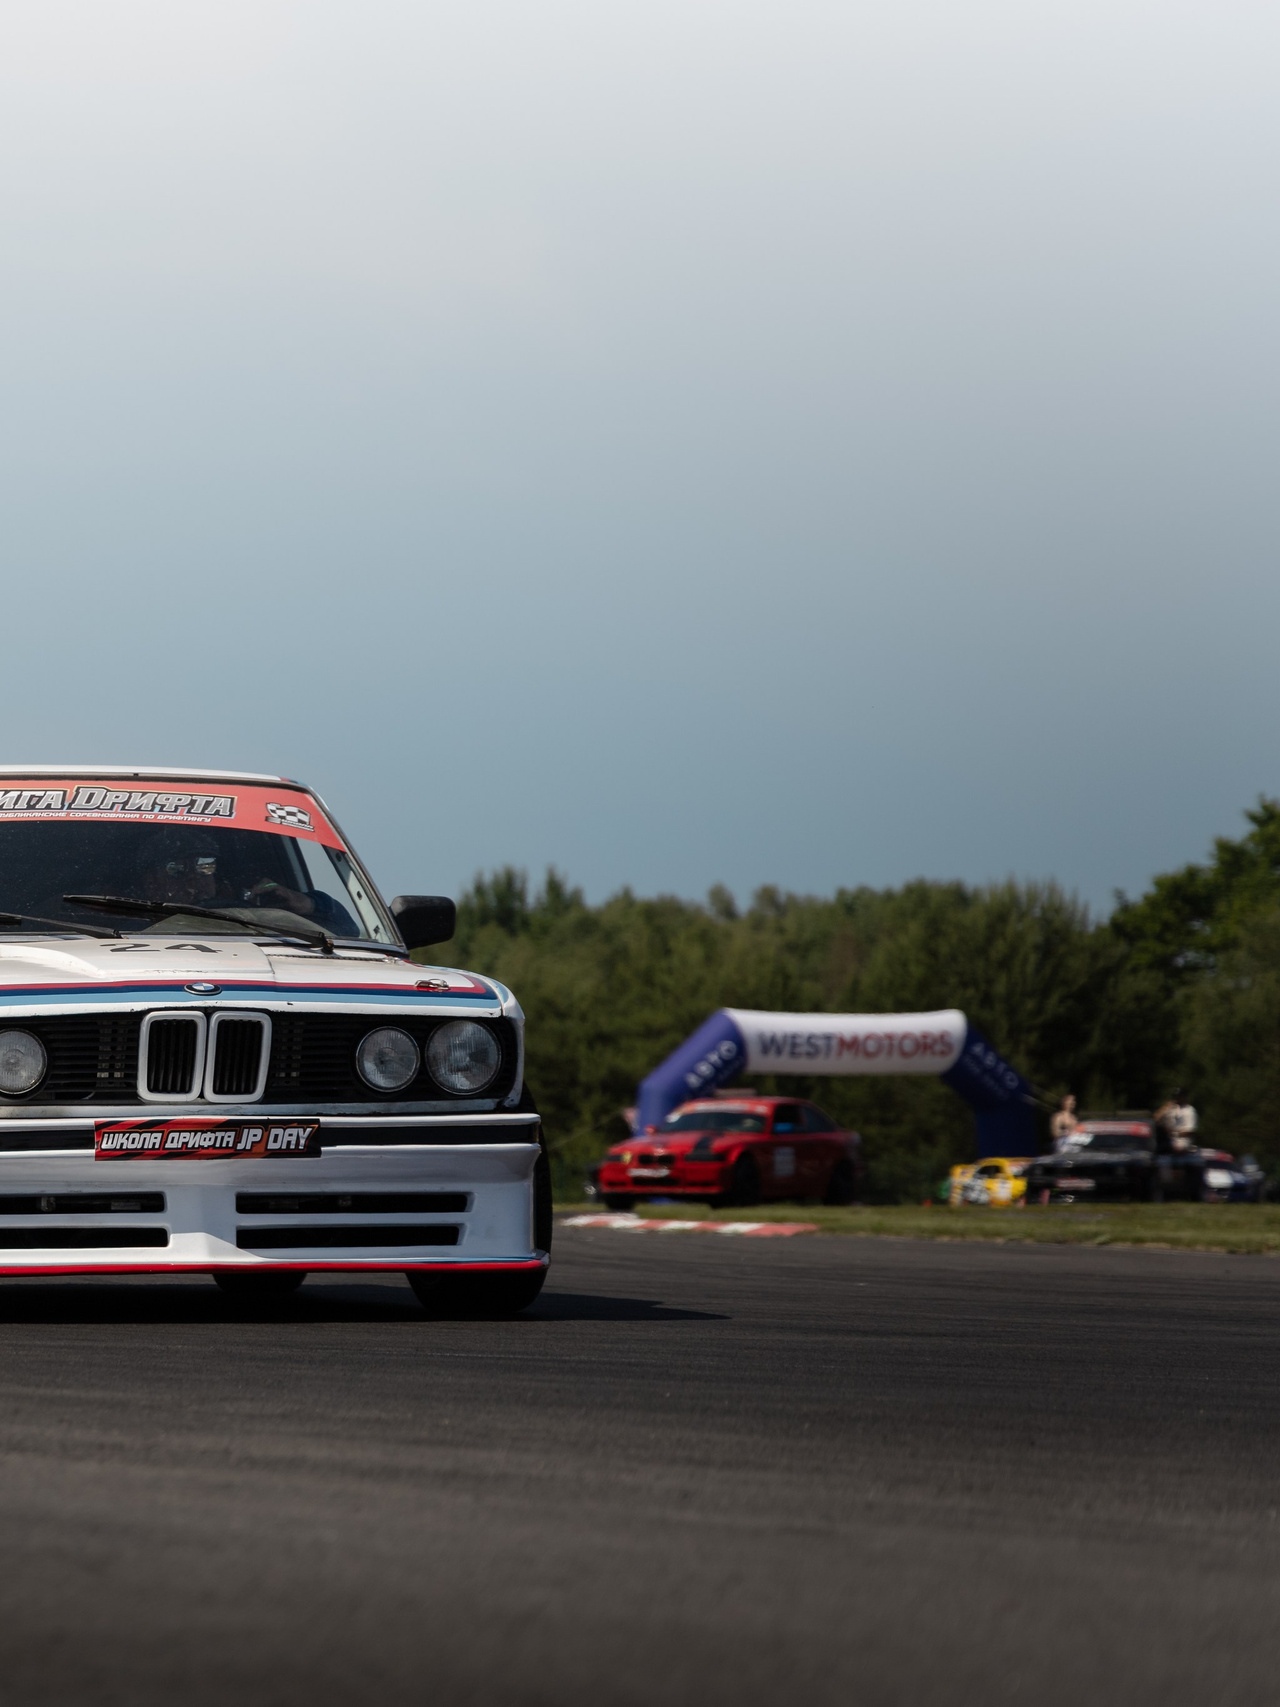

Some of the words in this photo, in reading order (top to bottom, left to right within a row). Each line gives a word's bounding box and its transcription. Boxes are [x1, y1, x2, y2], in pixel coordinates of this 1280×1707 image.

[70, 812, 140, 820] СОРЕВНОВАНИЯ
[157, 814, 212, 823] ДРИФТИНГУ
[758, 1031, 953, 1059] WESTMOTORS
[101, 1132, 162, 1149] ШКОЛА
[164, 1131, 234, 1149] ДРИФТА
[236, 1128, 264, 1150] JP
[267, 1127, 313, 1150] DAY
